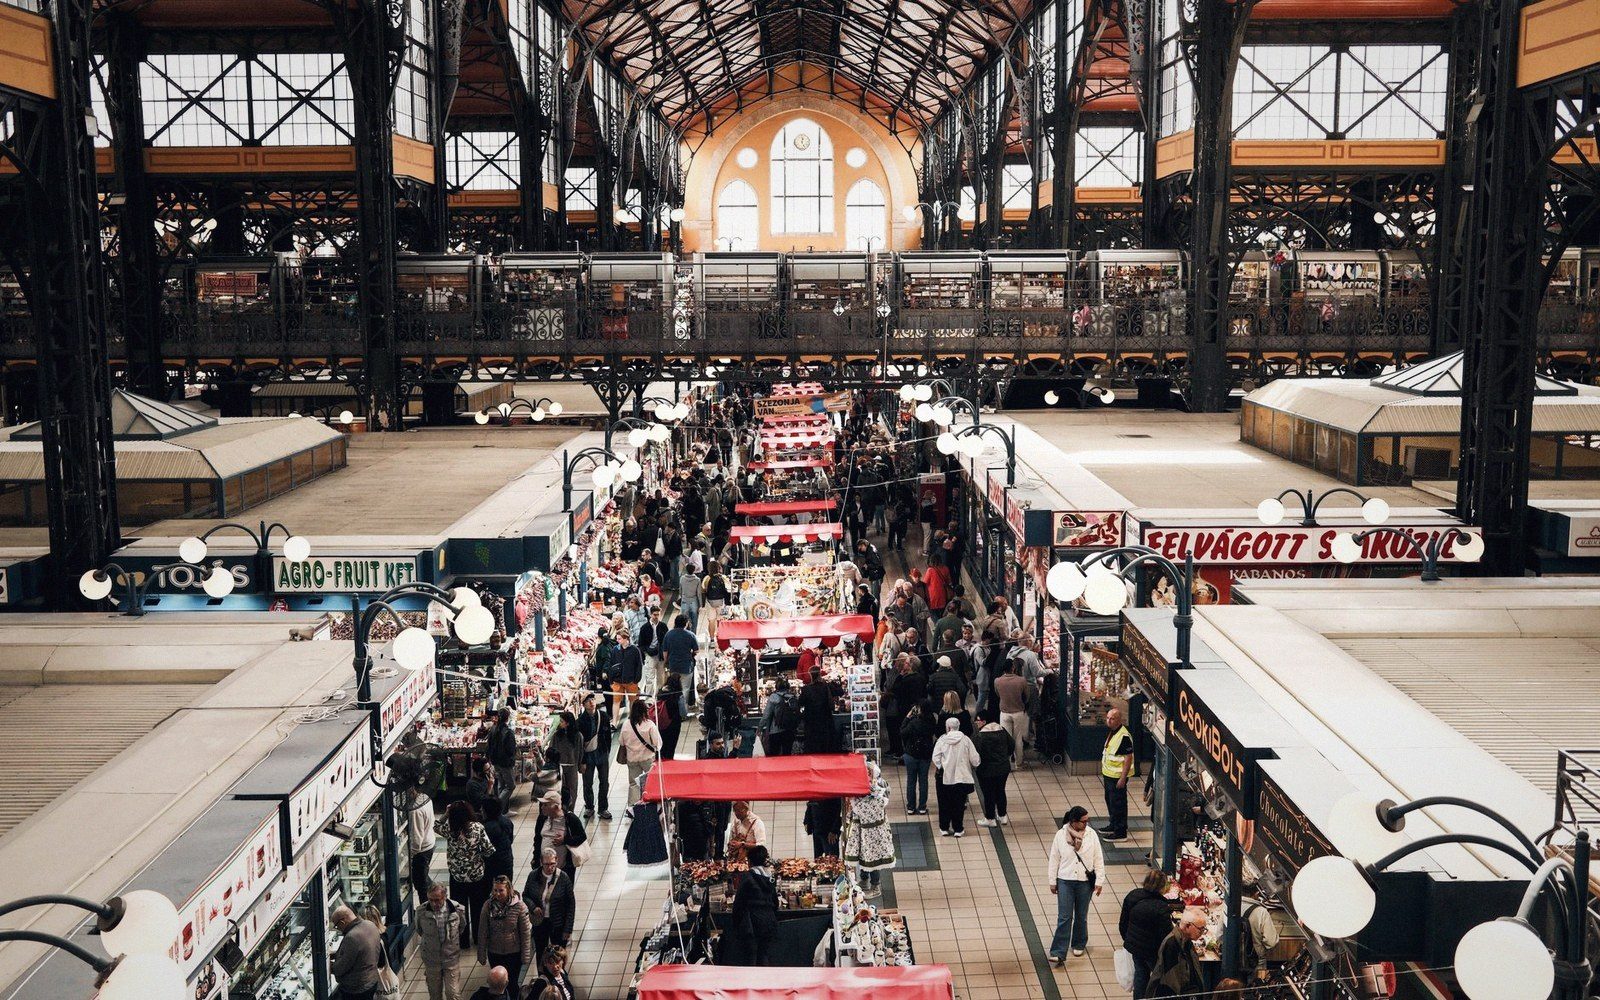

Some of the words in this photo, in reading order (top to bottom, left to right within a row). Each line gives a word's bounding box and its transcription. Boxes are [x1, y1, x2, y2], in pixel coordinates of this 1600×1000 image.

[757, 398, 800, 408] SZEZONJA
[1147, 529, 1309, 561] FELVÁGOTT
[151, 559, 251, 588] TOJS
[278, 560, 380, 588] AGRO-FRUIT
[1229, 569, 1305, 580] KABANOS
[1259, 790, 1304, 856] Chocolate
